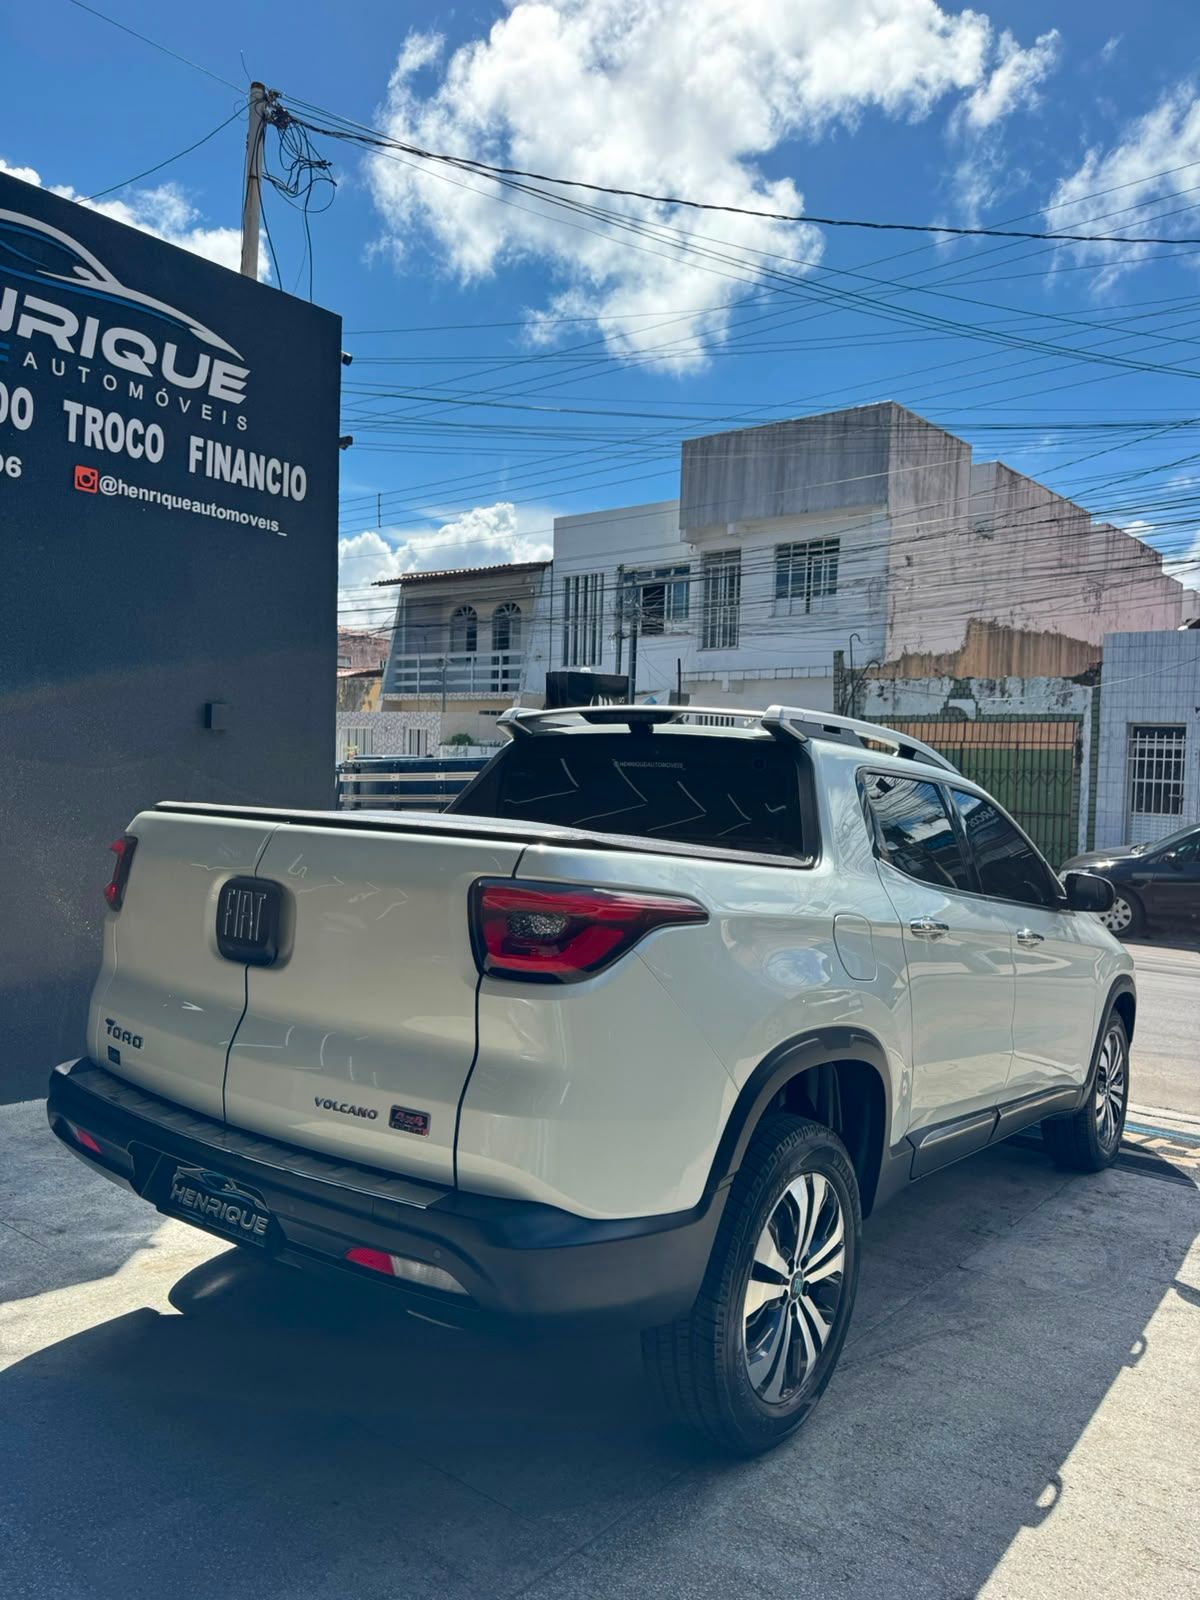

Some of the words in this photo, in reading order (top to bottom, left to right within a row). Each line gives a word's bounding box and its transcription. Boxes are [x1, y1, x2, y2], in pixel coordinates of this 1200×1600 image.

[23, 352, 248, 431] AUTOMÓVEIS
[0, 455, 22, 478] 6
[63, 400, 164, 464] TROCO
[189, 435, 307, 502] FINANCIO
[99, 475, 287, 536] @henriqueautomoveis_
[223, 889, 267, 942] FIAT
[105, 1017, 144, 1049] TORO
[314, 1096, 379, 1120] VOLCANO
[170, 1183, 269, 1236] HENRIQUE
